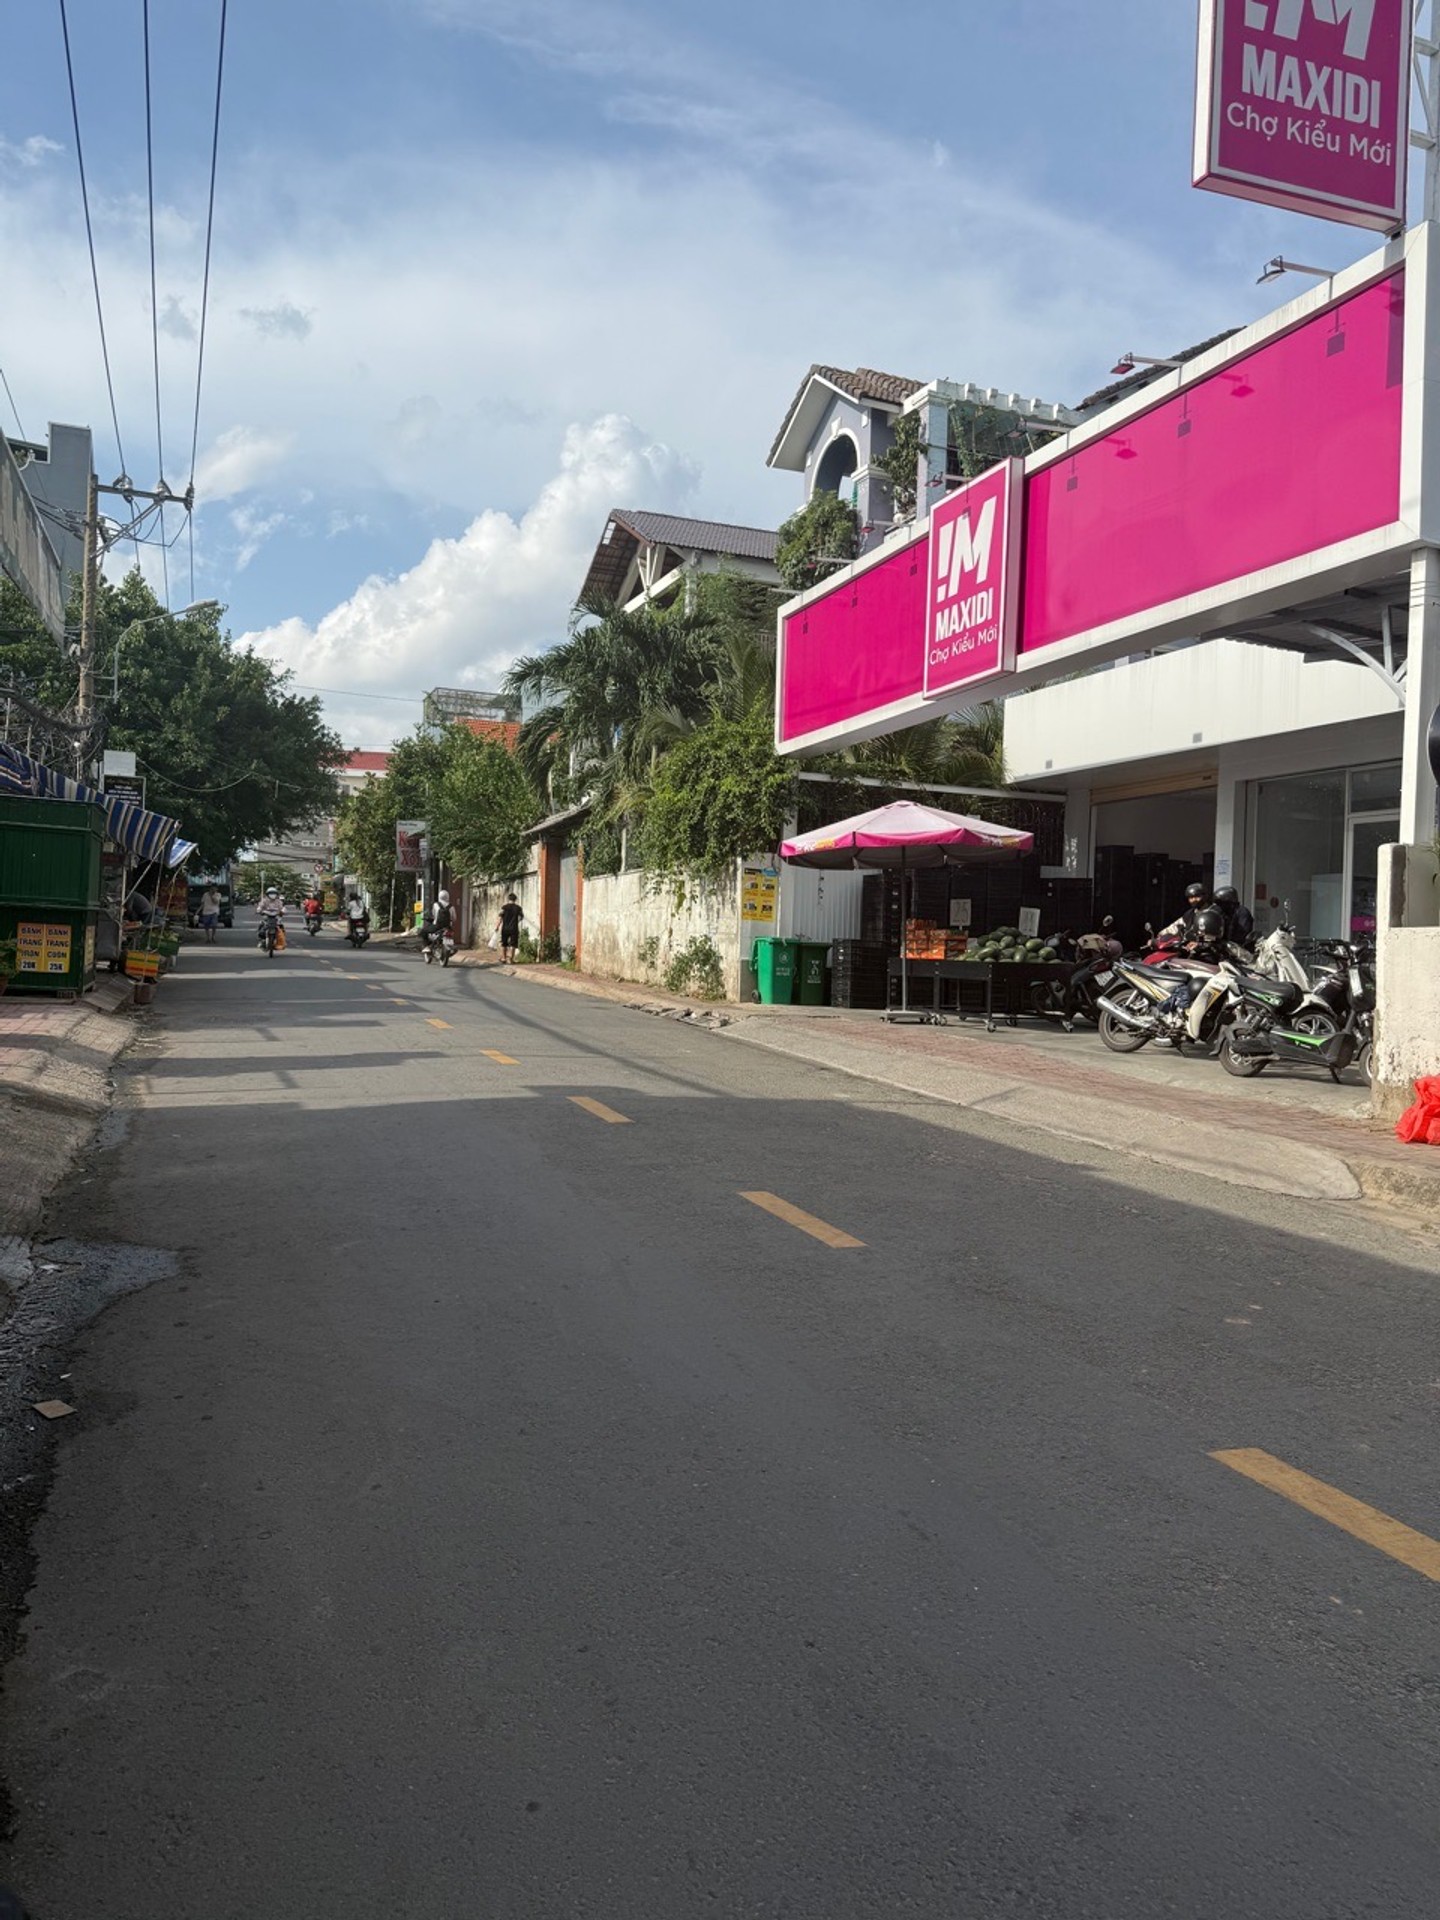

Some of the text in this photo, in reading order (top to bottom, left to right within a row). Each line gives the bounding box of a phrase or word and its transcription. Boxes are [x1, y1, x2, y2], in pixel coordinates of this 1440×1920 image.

[1242, 42, 1381, 129] MAXIDI
[1226, 102, 1392, 166] Chợ Kiểu Mới
[929, 623, 998, 665] Chợ Kiểu Mới
[935, 587, 994, 643] MAXIDI
